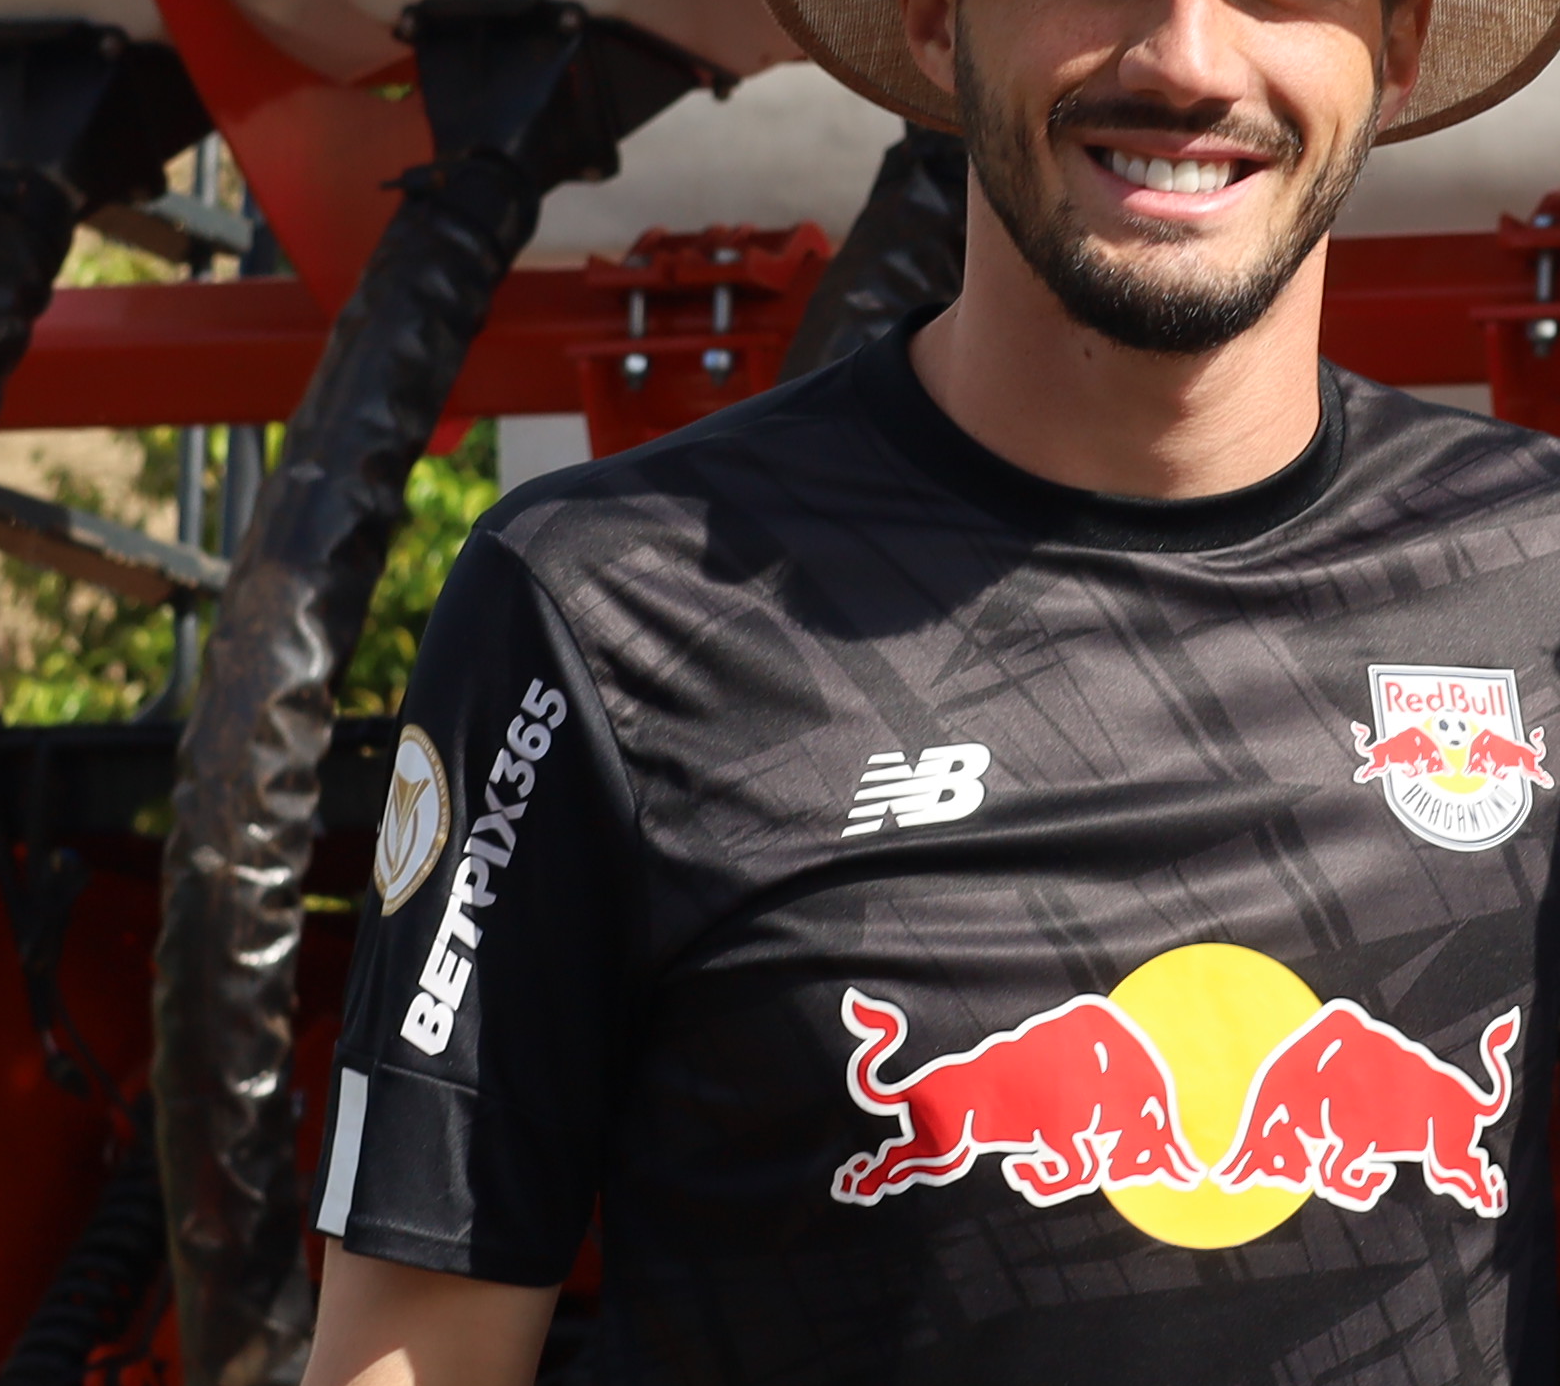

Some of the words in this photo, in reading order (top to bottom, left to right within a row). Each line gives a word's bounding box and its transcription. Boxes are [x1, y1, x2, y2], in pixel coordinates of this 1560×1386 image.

[1384, 681, 1445, 713] Red
[1449, 683, 1507, 717] Bull
[841, 742, 991, 839] NB
[400, 677, 568, 1057] BETPIX365
